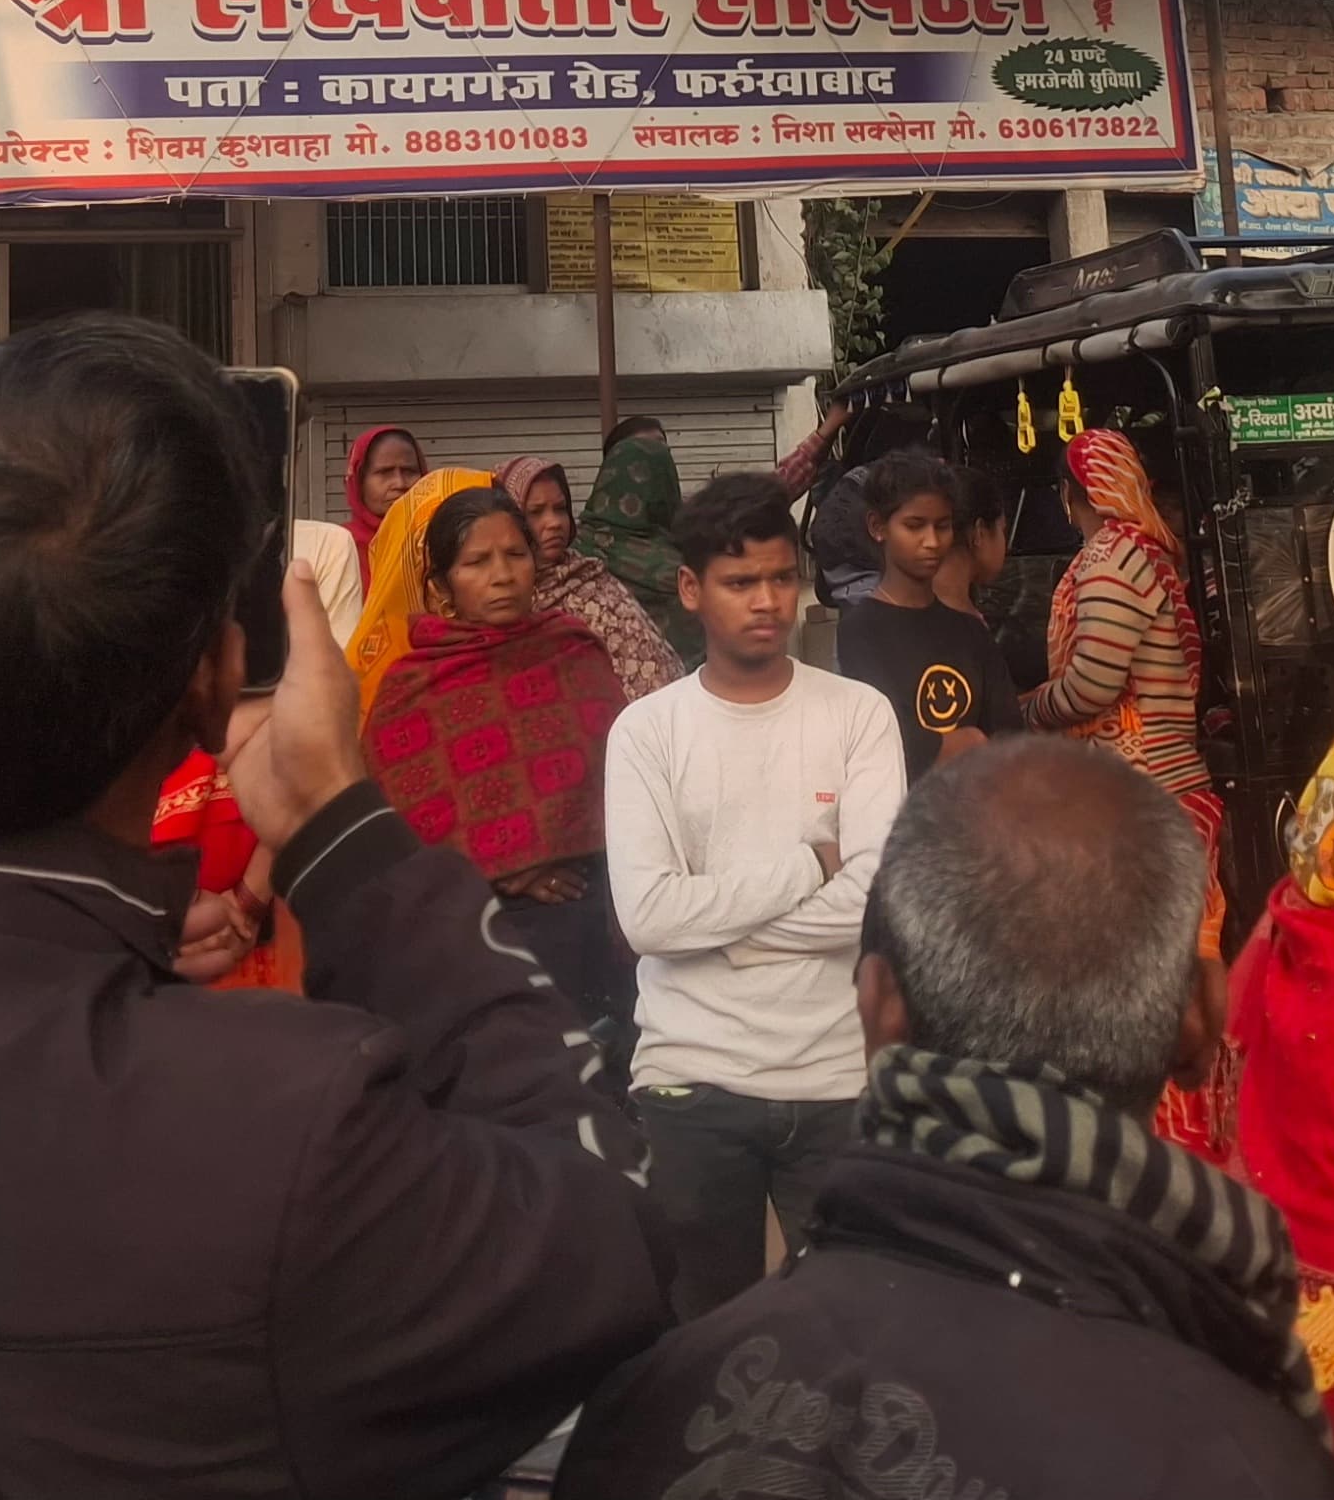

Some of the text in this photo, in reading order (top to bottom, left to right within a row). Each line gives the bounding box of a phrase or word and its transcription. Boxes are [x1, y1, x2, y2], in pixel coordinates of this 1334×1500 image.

[1043, 50, 1065, 65] 24
[164, 76, 267, 108] पता
[319, 63, 555, 104] कायमगंज
[127, 127, 207, 163] शिवम
[218, 134, 332, 168] कुशवाहा
[405, 125, 589, 155] 8883101083
[633, 116, 740, 147] संचालक
[772, 112, 835, 145] निशा
[844, 112, 936, 145] सक्सेना
[998, 115, 1160, 140] 6306173822
